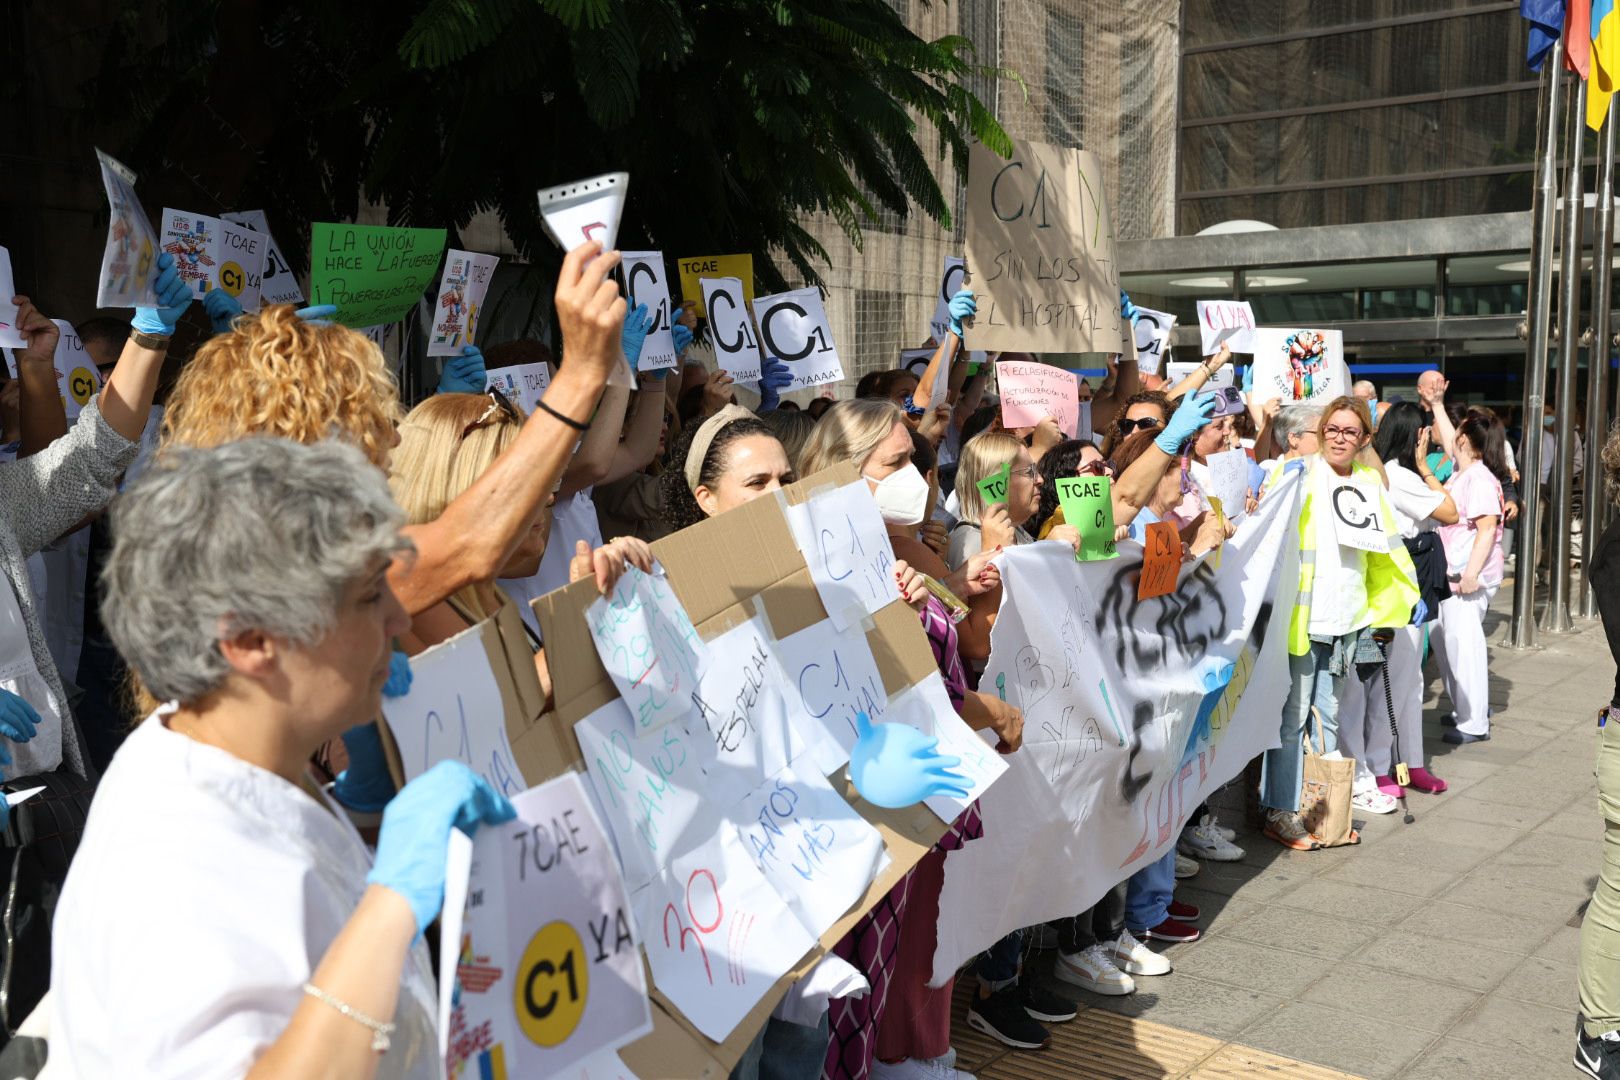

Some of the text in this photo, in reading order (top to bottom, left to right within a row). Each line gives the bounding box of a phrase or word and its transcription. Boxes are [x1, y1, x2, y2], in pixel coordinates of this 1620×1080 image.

[991, 161, 1051, 229] C1
[224, 229, 258, 255] TCAE
[329, 228, 415, 252] LA UNIÓN
[176, 270, 209, 281] VIEMBRE
[325, 256, 362, 271] HACE
[682, 260, 718, 274] TCAE
[987, 249, 1024, 281] SIN
[1037, 256, 1080, 283] LOS
[222, 270, 242, 290] C1
[246, 271, 261, 290] YA
[629, 262, 670, 335] C1
[708, 289, 756, 354] C1
[1205, 305, 1226, 331] C1
[762, 301, 834, 362] C1
[1137, 314, 1162, 356] C1
[72, 378, 94, 397] C1
[523, 373, 546, 391] TCAE
[1182, 371, 1220, 383] TE
[1061, 483, 1101, 498] TCAE
[1095, 509, 1106, 529] C1
[1332, 485, 1384, 532] C1
[822, 513, 865, 582] C1
[1156, 530, 1172, 556] C1
[799, 649, 850, 719] C1
[596, 728, 633, 809] NO
[513, 808, 590, 881] TCAE
[588, 906, 634, 964] YA
[523, 948, 579, 1020] C1
